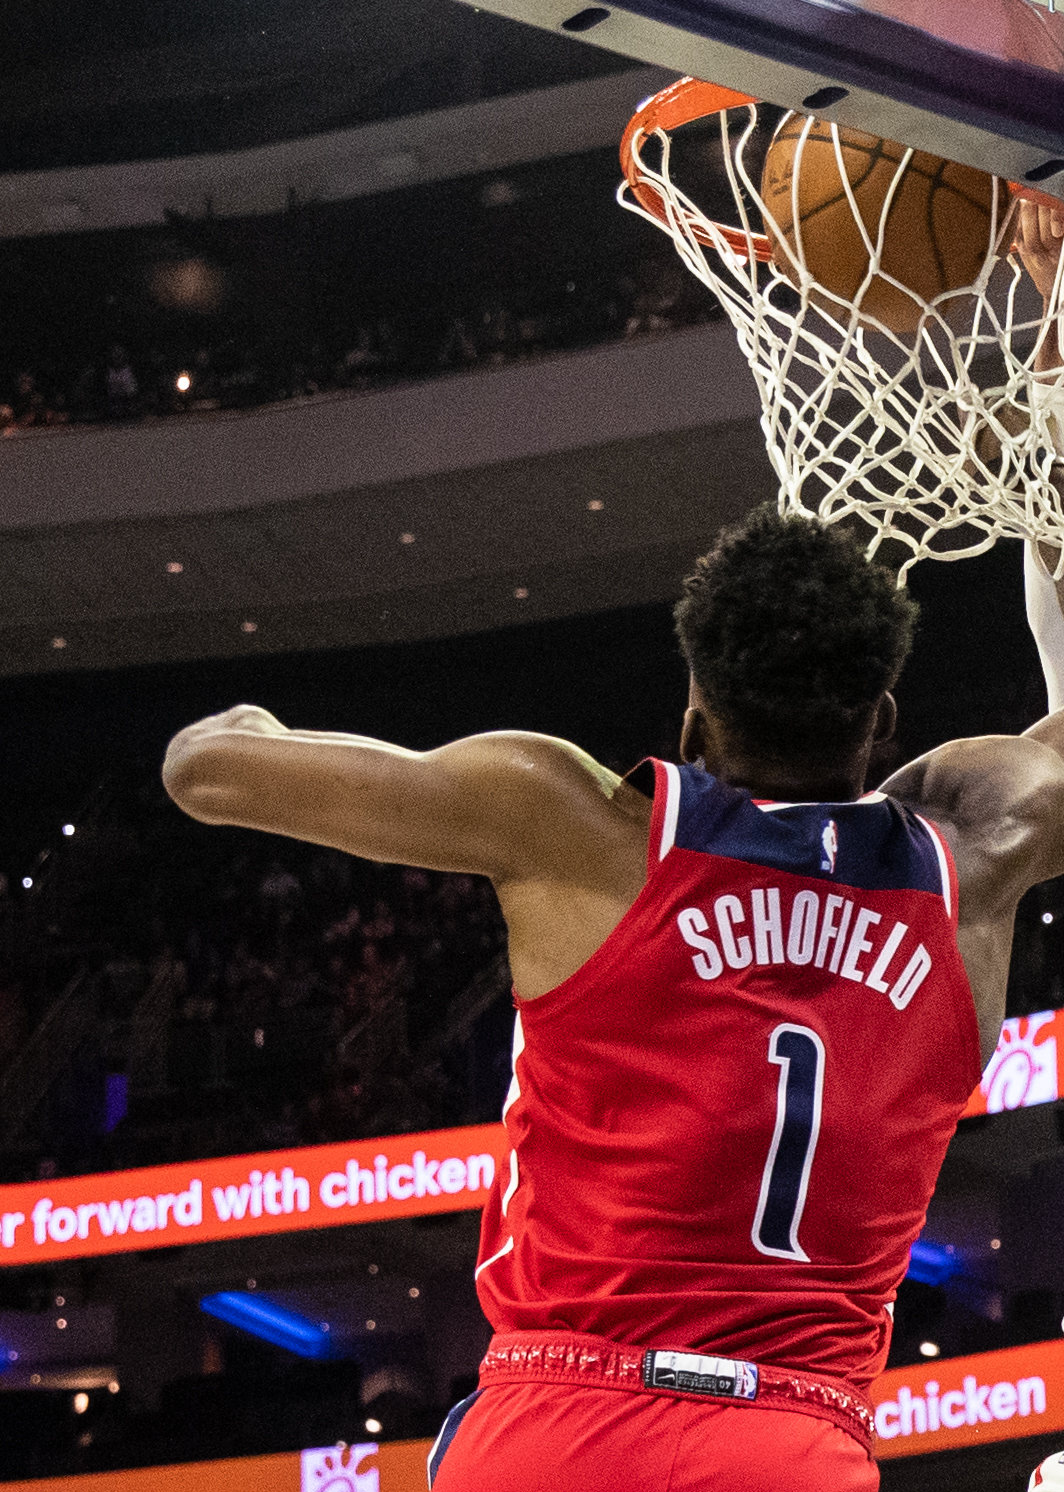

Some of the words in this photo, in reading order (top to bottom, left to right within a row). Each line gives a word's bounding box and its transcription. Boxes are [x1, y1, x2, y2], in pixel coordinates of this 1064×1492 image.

[677, 887, 932, 1011] SCHOFIELD
[751, 1023, 826, 1263] 1
[32, 1179, 202, 1245] forward
[211, 1166, 310, 1222] with
[319, 1151, 495, 1210] chicken
[874, 1374, 1046, 1440] chicken
